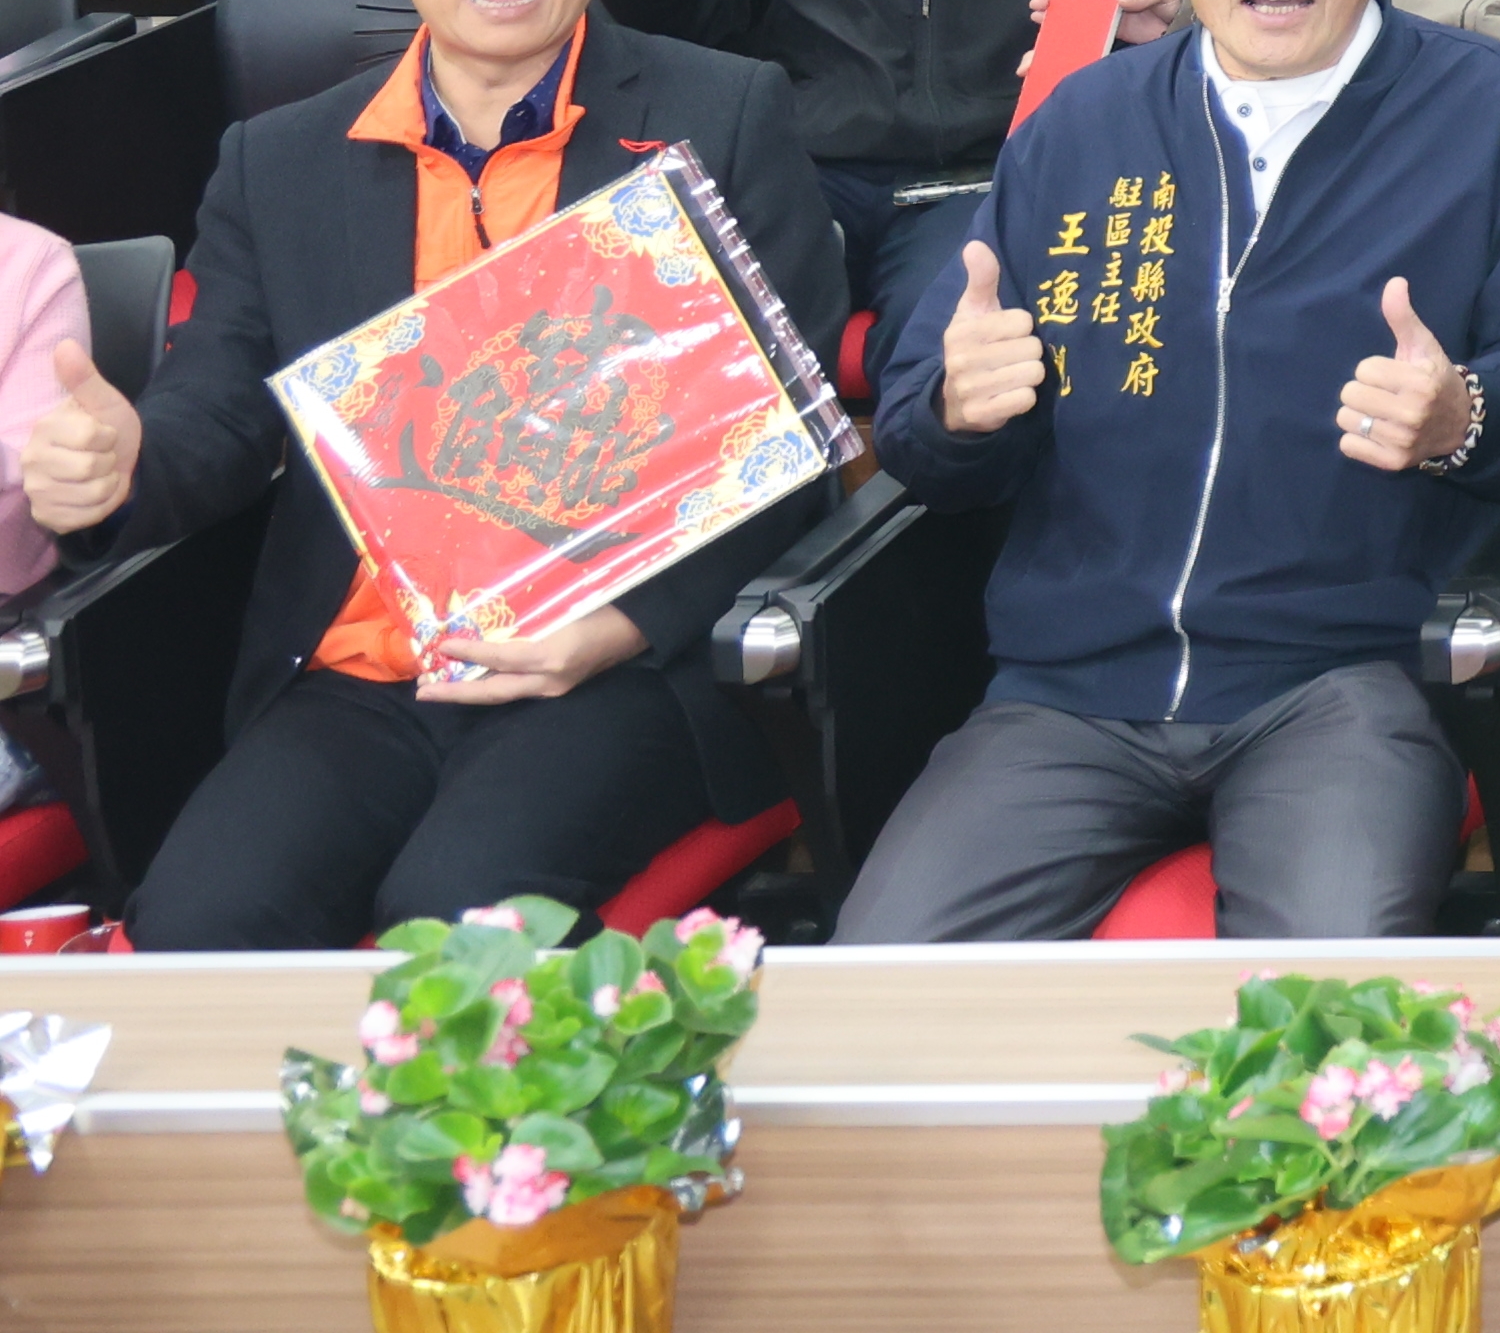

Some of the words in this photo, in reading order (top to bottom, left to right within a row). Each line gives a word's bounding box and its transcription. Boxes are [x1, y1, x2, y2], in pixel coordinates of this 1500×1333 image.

[1091, 176, 1142, 323] 駐區主任
[1121, 170, 1177, 397] 南投縣政府
